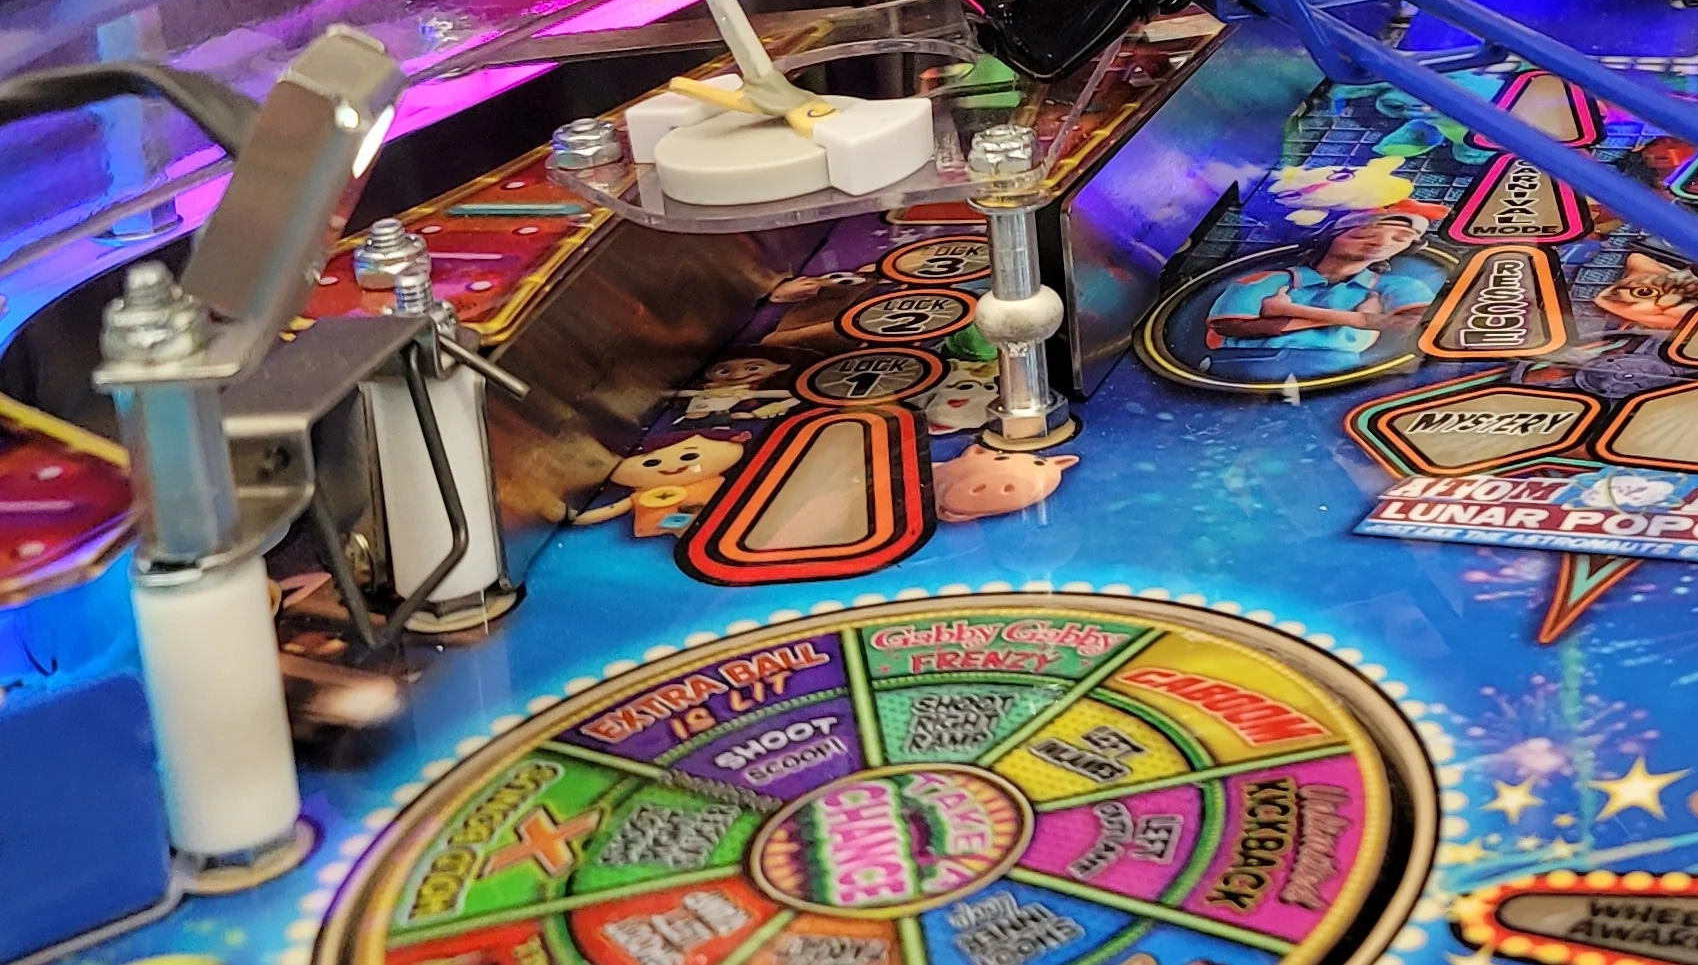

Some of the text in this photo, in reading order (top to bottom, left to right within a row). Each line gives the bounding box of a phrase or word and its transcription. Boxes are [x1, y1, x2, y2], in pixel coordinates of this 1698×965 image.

[1492, 158, 1542, 225] CARNIVAL
[1472, 225, 1559, 235] MODE
[922, 244, 983, 257] OCK
[915, 256, 965, 277] 3
[883, 298, 951, 311] LOCK
[1459, 259, 1529, 347] RESCUE
[878, 310, 932, 335] 2
[837, 358, 909, 372] LOCK
[845, 372, 883, 398] 1
[1405, 410, 1577, 436] MYSTERY
[1386, 475, 1571, 504] ATOM
[1379, 501, 1549, 529] LUNAR
[869, 619, 1131, 657] Gabby Gabby
[910, 650, 1063, 674] FRENZY
[579, 641, 831, 744] EXTRA BALL
[669, 670, 794, 741] IS LIT
[1115, 666, 1334, 746] CABOOM
[713, 715, 839, 771] SHOOT
[902, 771, 994, 856] TAKE
[818, 779, 917, 907] CHANCE
[1202, 776, 1298, 913] KICKBACK
